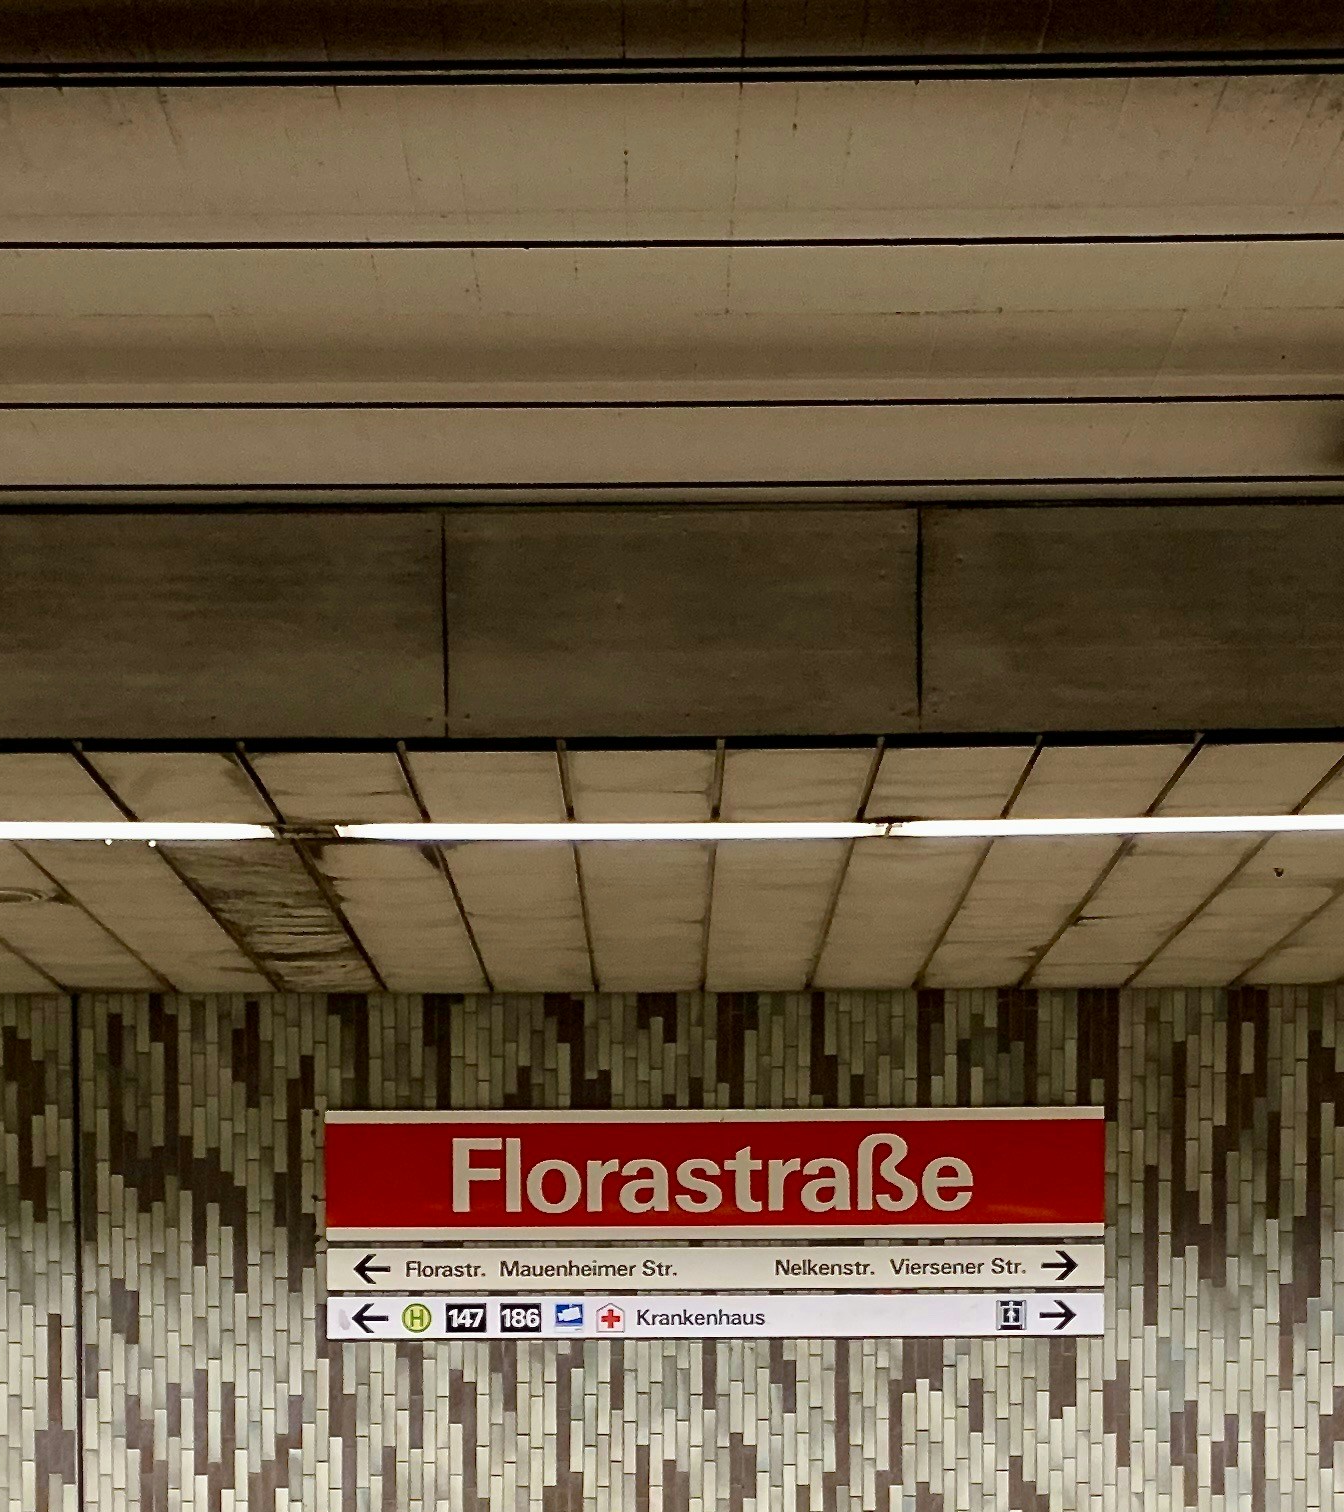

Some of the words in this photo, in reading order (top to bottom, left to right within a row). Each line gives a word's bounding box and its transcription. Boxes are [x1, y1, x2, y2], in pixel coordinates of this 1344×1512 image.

[452, 1133, 974, 1213] Florastraße
[405, 1260, 486, 1278] Florastr.
[500, 1259, 637, 1278] Mauenheimer
[642, 1259, 678, 1277] Str.
[775, 1258, 875, 1277] Nelkenstr.
[890, 1257, 985, 1276] Viersener
[991, 1256, 1027, 1275] Str.
[447, 1308, 484, 1328] 147
[501, 1308, 540, 1328] 186
[636, 1306, 766, 1327] Krankenhaus
